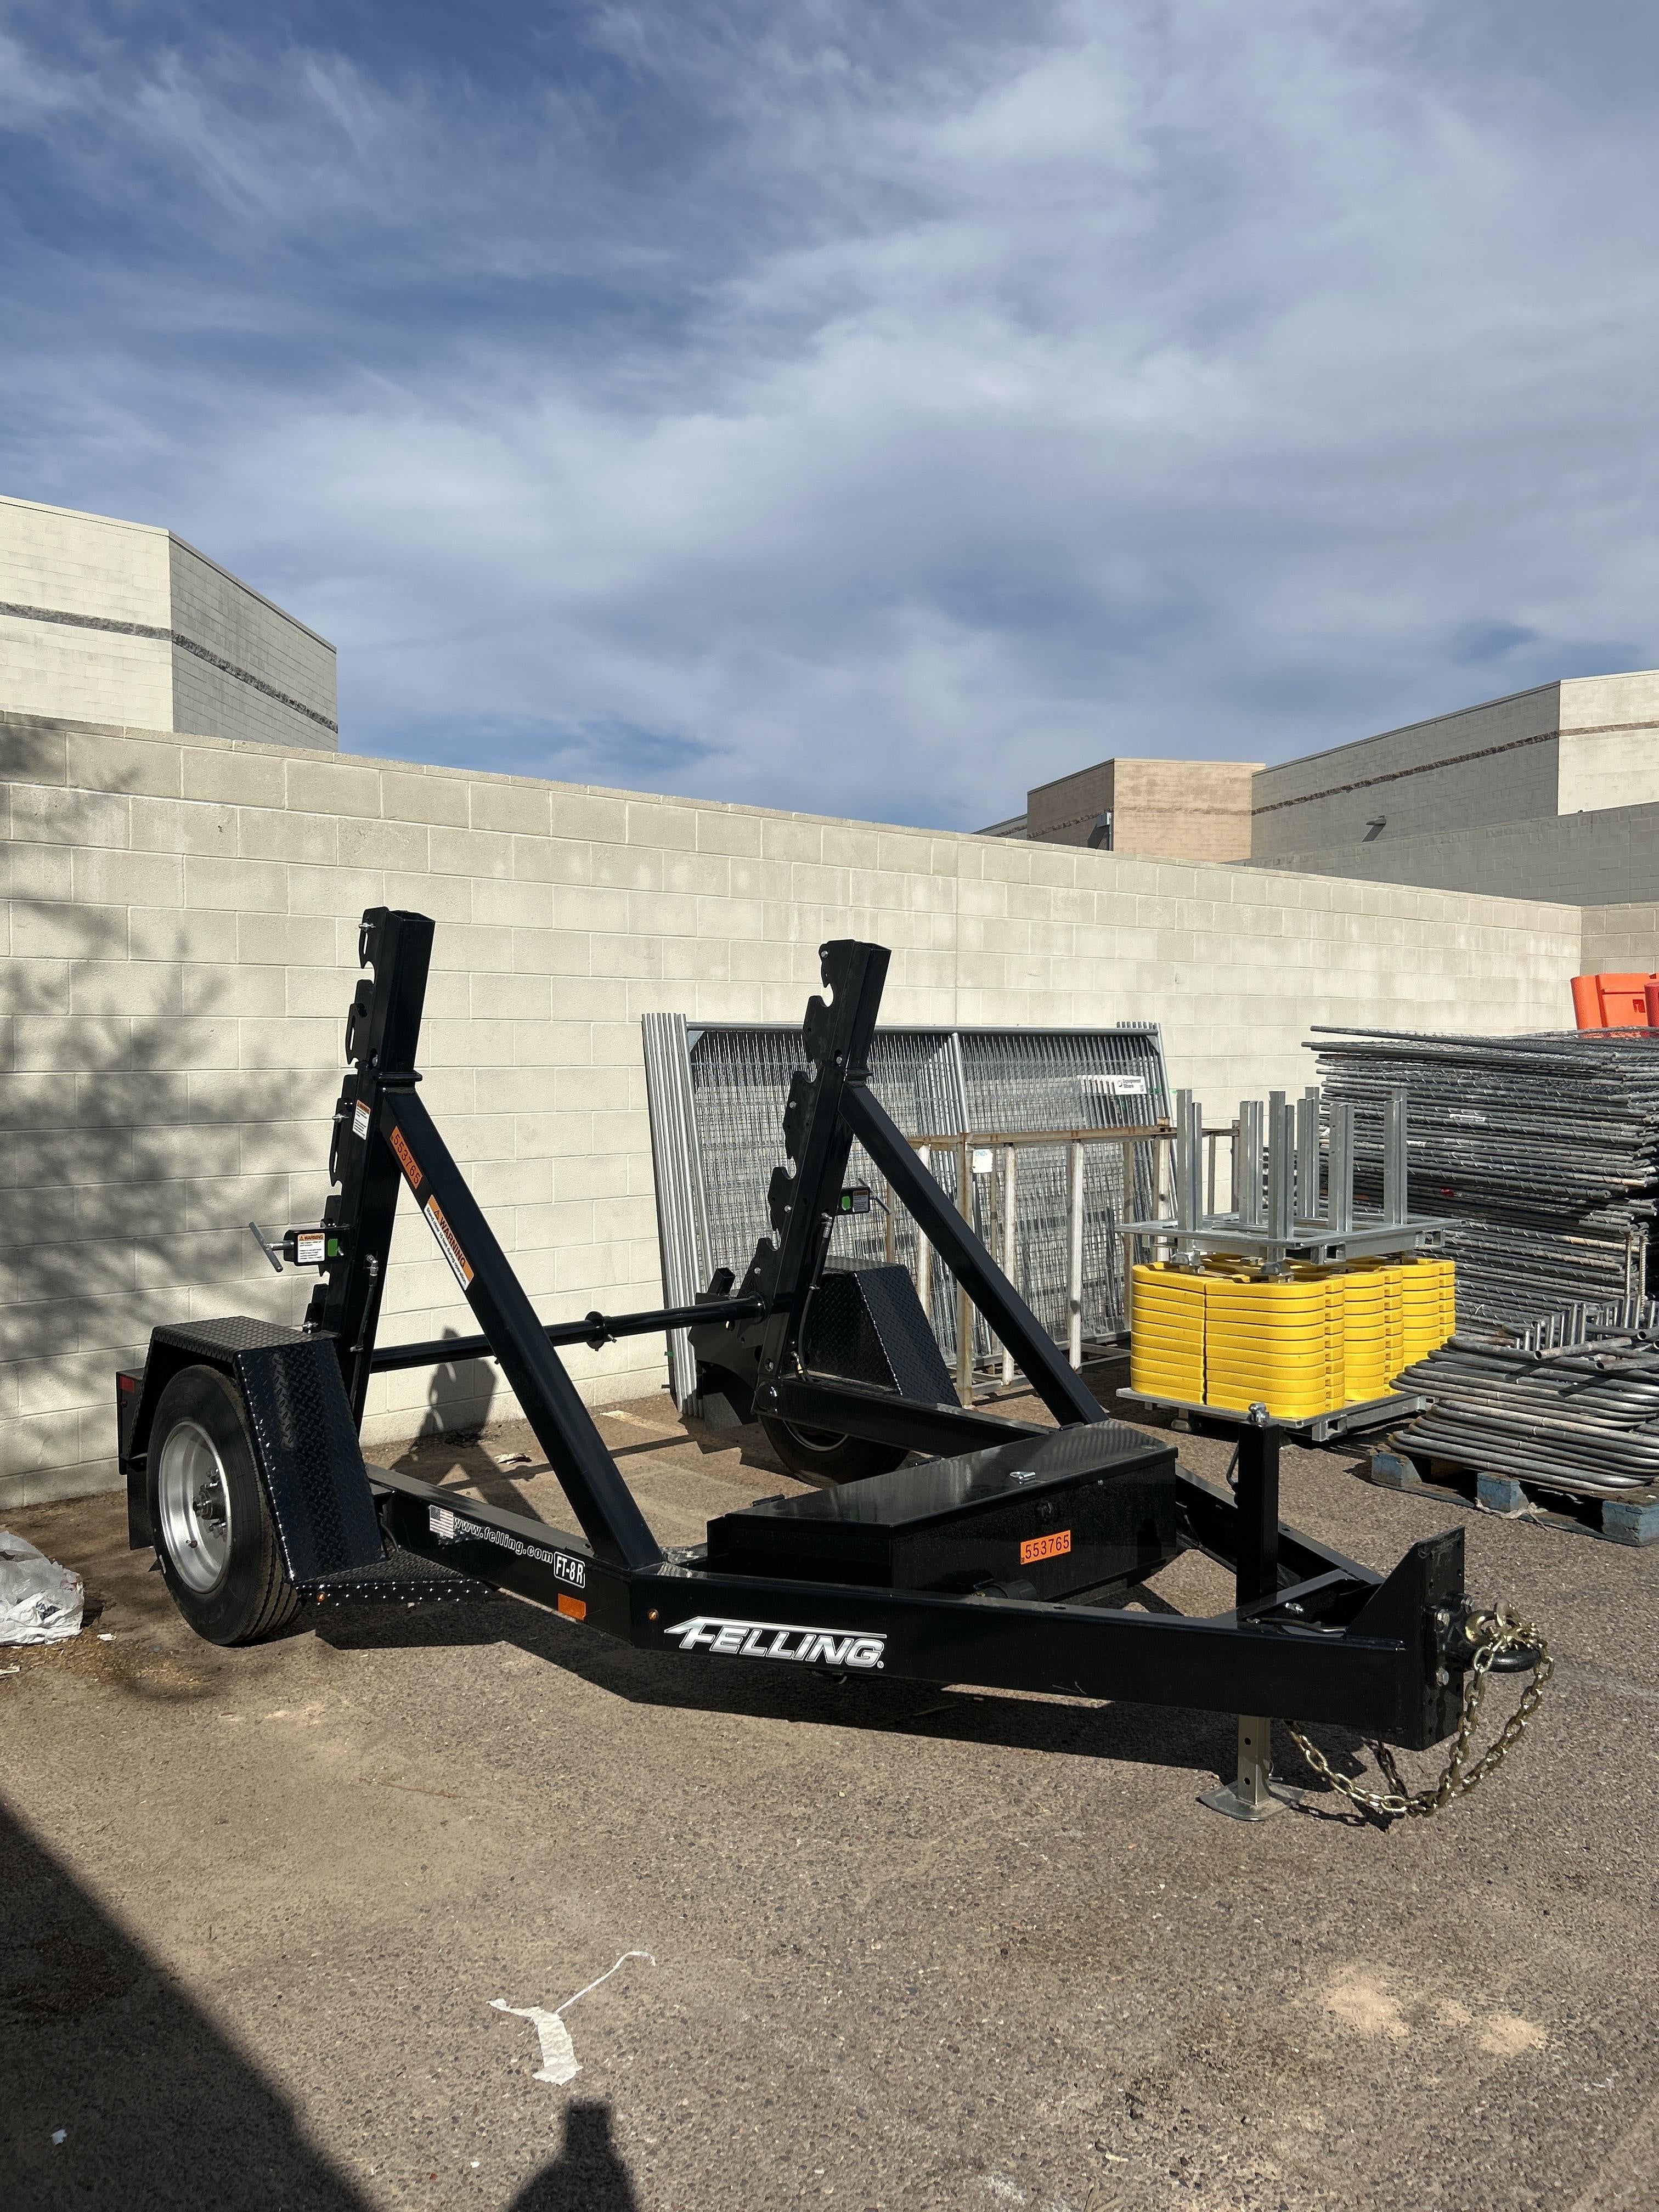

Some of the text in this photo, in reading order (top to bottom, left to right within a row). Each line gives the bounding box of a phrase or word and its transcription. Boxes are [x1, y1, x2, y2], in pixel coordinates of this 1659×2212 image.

[393, 1133, 421, 1184] 553765
[439, 1217, 466, 1268] WARNING
[447, 1247, 455, 1263] during
[453, 1516, 554, 1564] www.felling.com
[1025, 1534, 1069, 1559] 553765
[664, 1616, 887, 1668] FELLING
